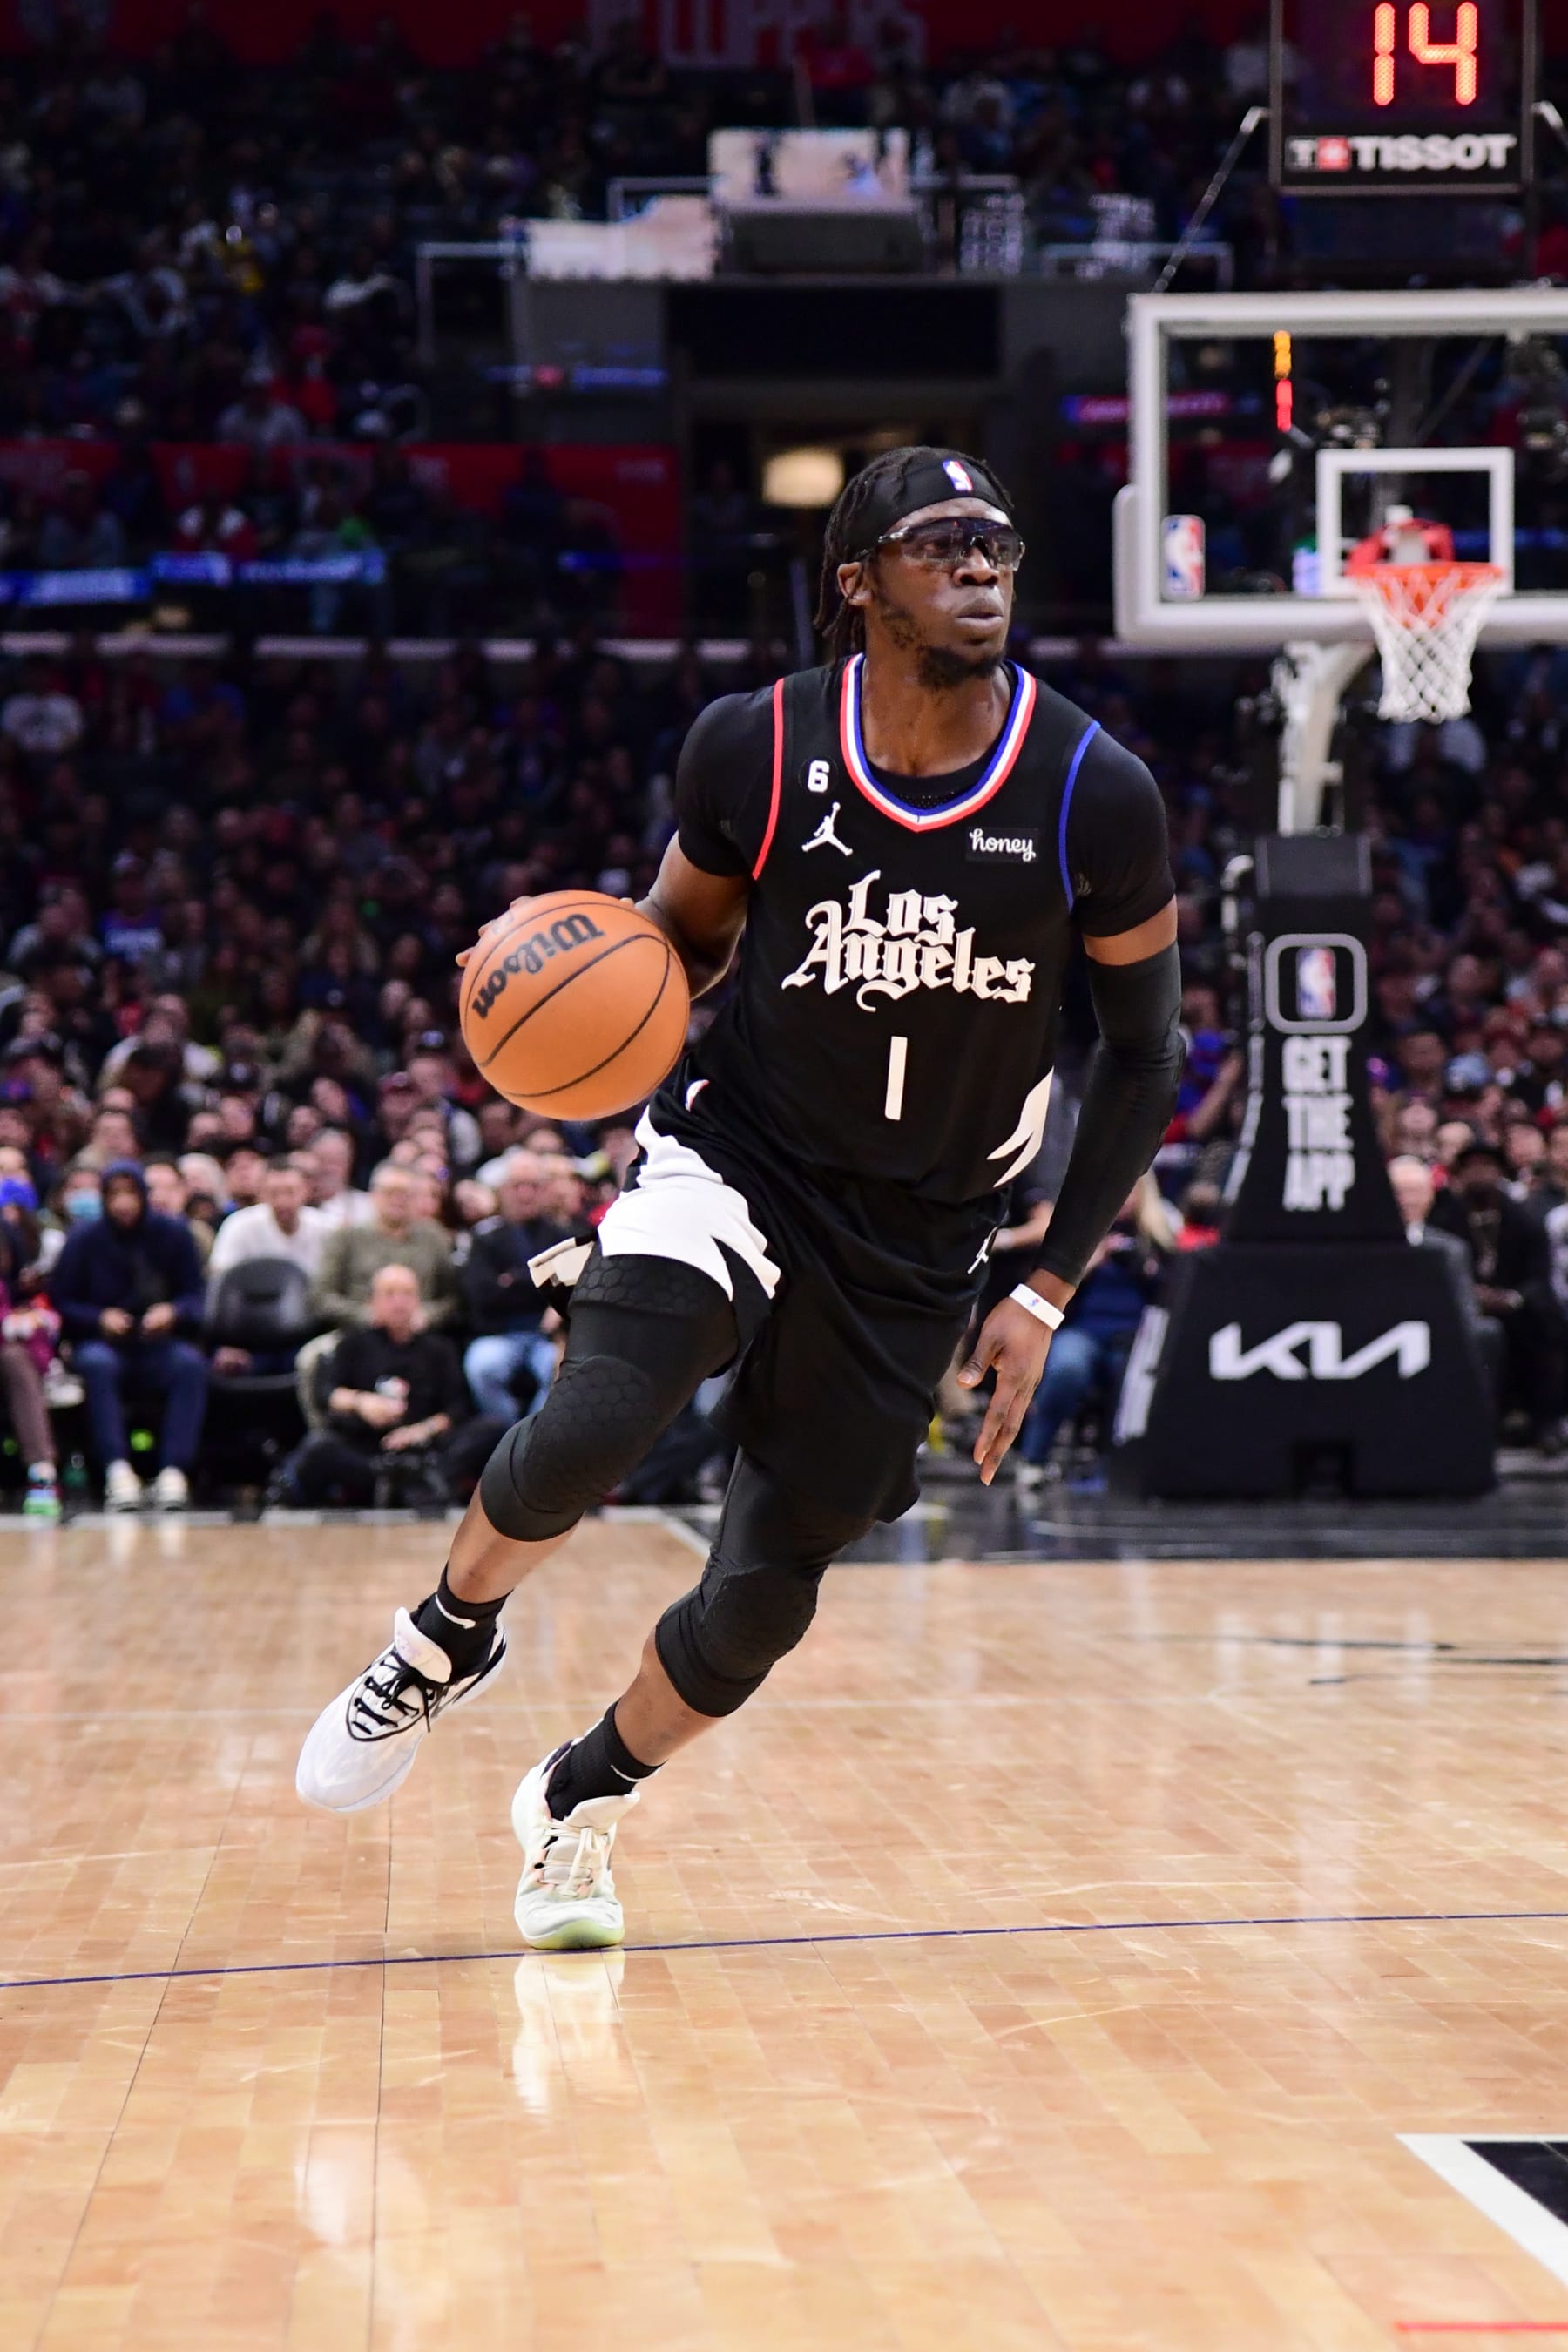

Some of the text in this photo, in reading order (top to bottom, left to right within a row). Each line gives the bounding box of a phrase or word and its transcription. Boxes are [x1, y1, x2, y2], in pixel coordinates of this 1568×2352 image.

[1374, 2, 1477, 105] 14
[1351, 134, 1517, 170] TISSOT
[808, 760, 830, 793] 6
[969, 828, 1037, 862] honey
[841, 869, 959, 946] Los
[471, 913, 605, 1019] Wilson
[781, 899, 1036, 1012] Angeles
[884, 1036, 908, 1121] 1
[1281, 1035, 1352, 1091] GET
[1281, 1092, 1355, 1149] THE
[1281, 1152, 1355, 1212] APP
[1208, 1321, 1430, 1380] KIA
